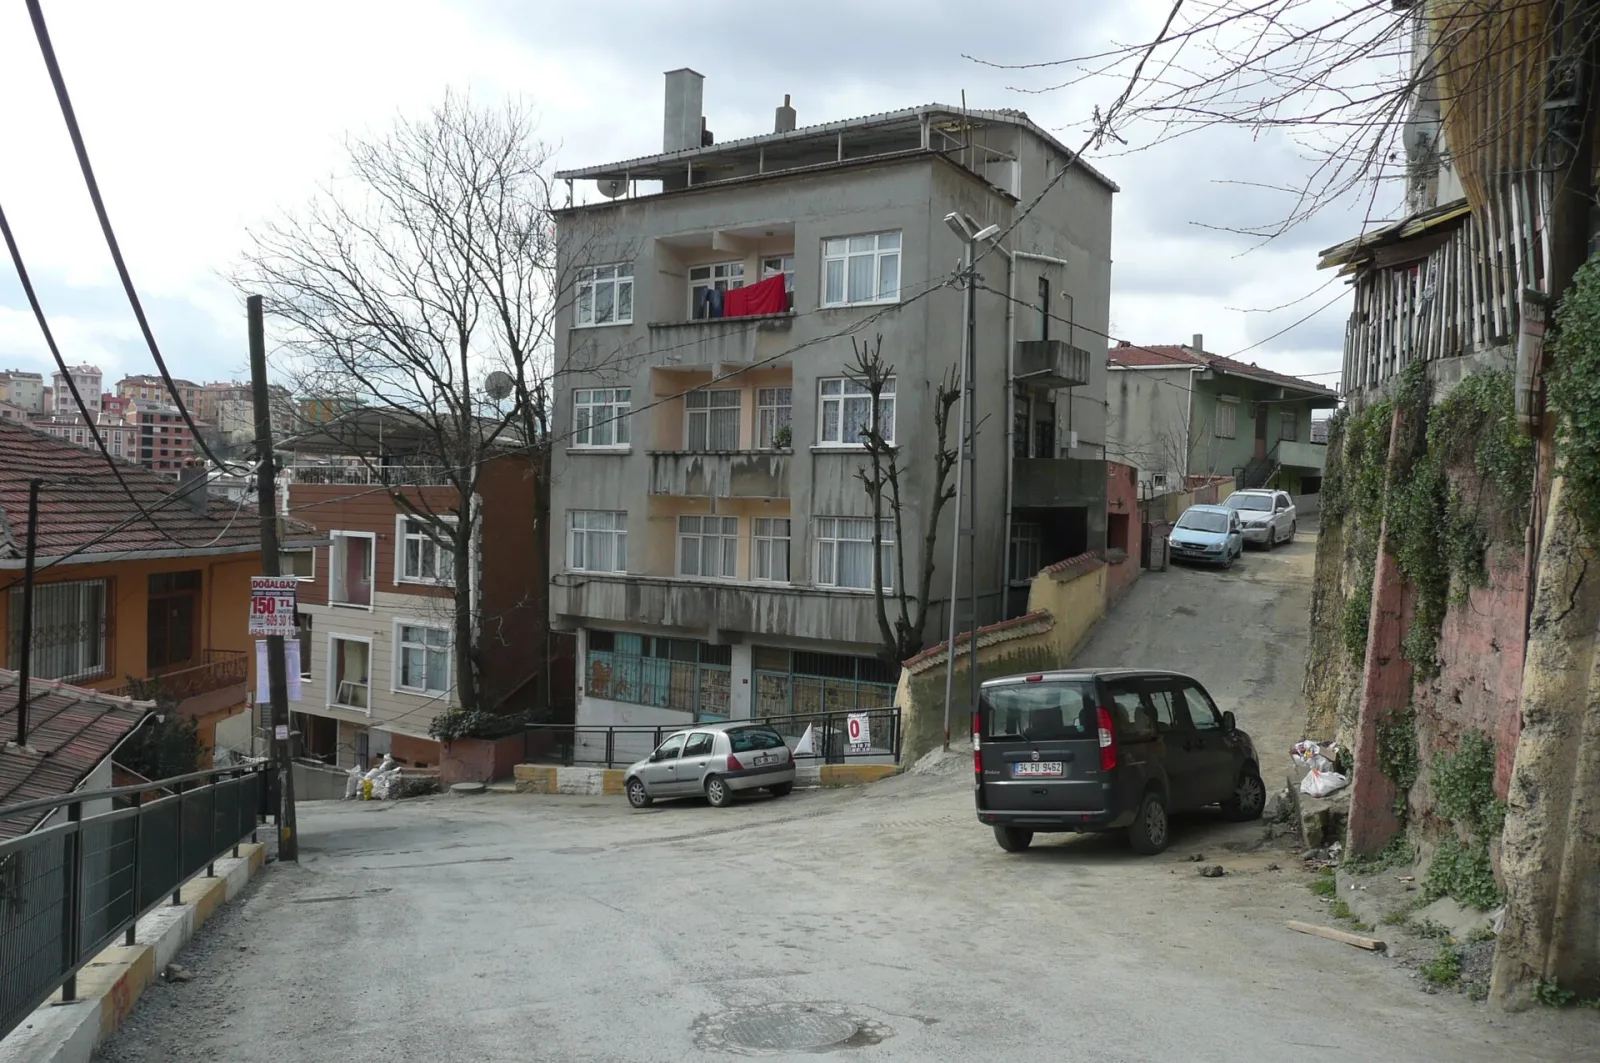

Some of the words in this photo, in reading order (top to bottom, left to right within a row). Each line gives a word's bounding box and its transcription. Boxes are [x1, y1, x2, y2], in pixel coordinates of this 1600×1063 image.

[252, 579, 296, 589] DOĞALGAZ
[252, 597, 276, 615] 150
[278, 599, 293, 608] TL
[850, 719, 860, 738] 0
[1019, 763, 1028, 772] 34
[1030, 763, 1040, 772] FU
[1043, 763, 1061, 772] 9462
